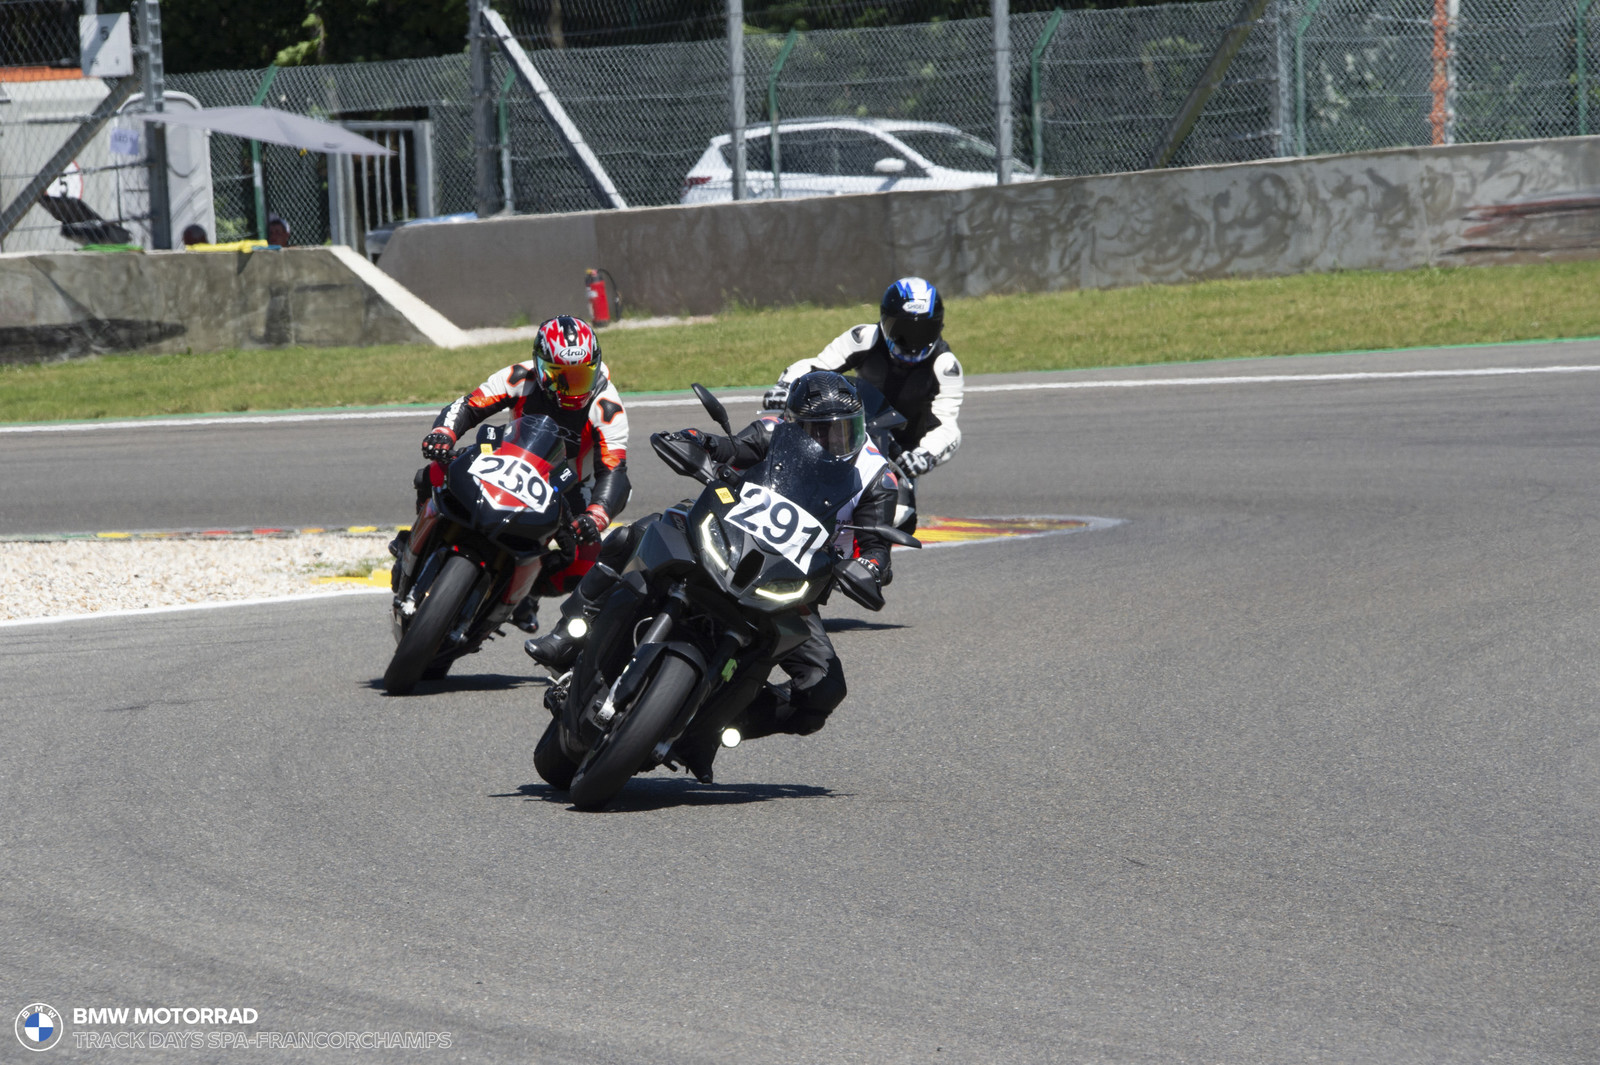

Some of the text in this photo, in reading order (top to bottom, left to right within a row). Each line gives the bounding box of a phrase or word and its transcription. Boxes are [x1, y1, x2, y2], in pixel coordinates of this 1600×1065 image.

[907, 303, 925, 311] SHOEI
[560, 348, 587, 358] Arai
[478, 456, 548, 507] 259
[728, 488, 823, 566] 291
